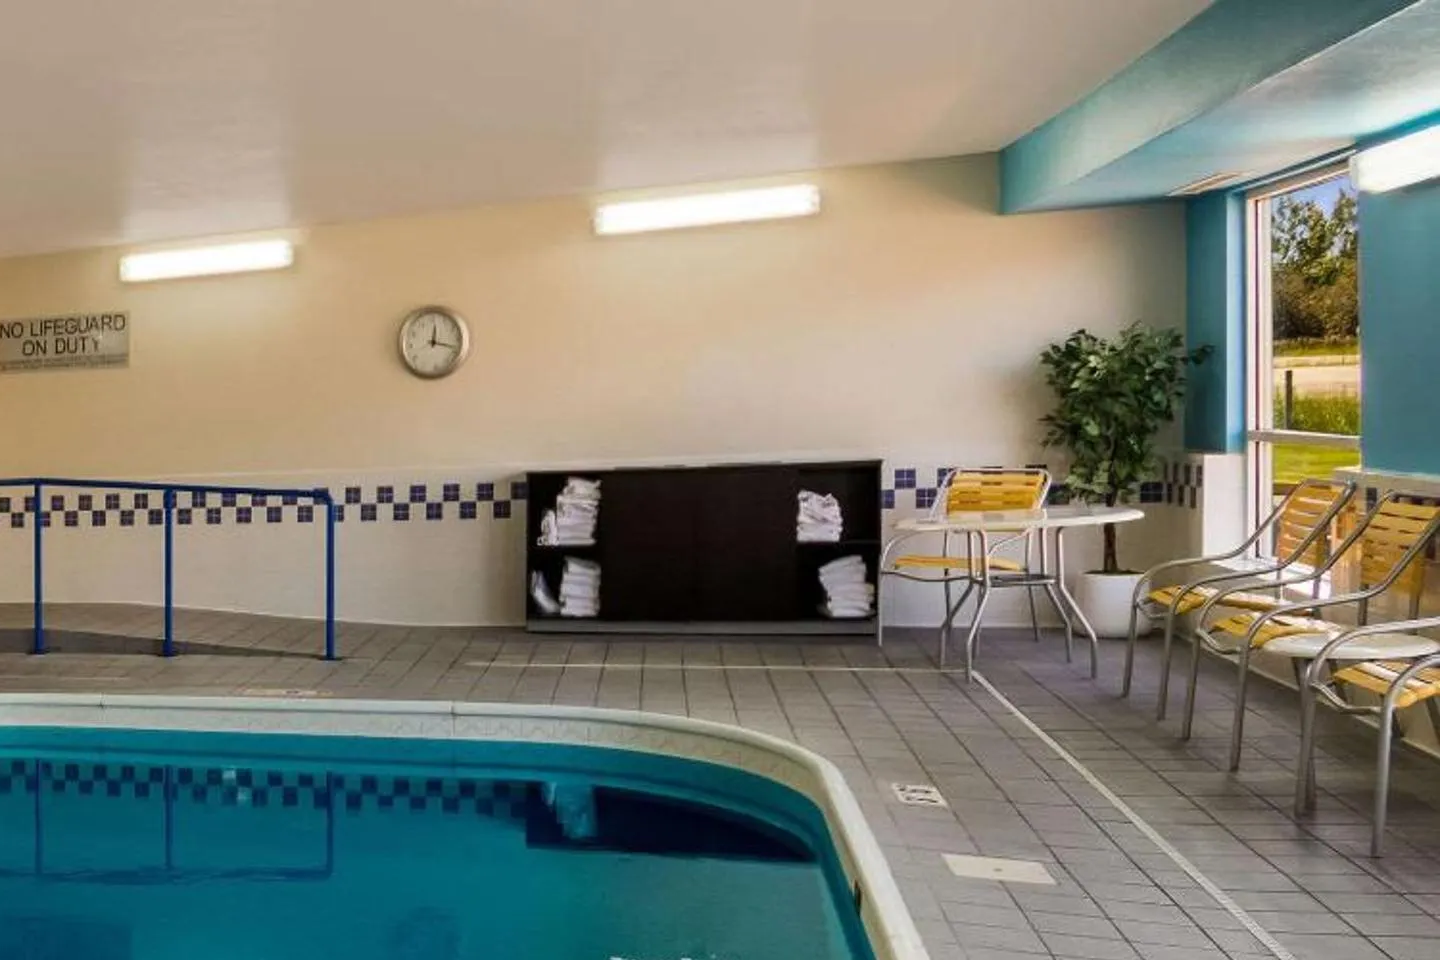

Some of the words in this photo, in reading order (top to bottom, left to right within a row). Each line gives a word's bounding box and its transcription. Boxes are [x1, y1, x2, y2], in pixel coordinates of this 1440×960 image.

[0, 322, 24, 339] NO
[30, 314, 126, 337] LIFEGUARD
[22, 339, 47, 356] ON
[55, 336, 100, 354] DUTY
